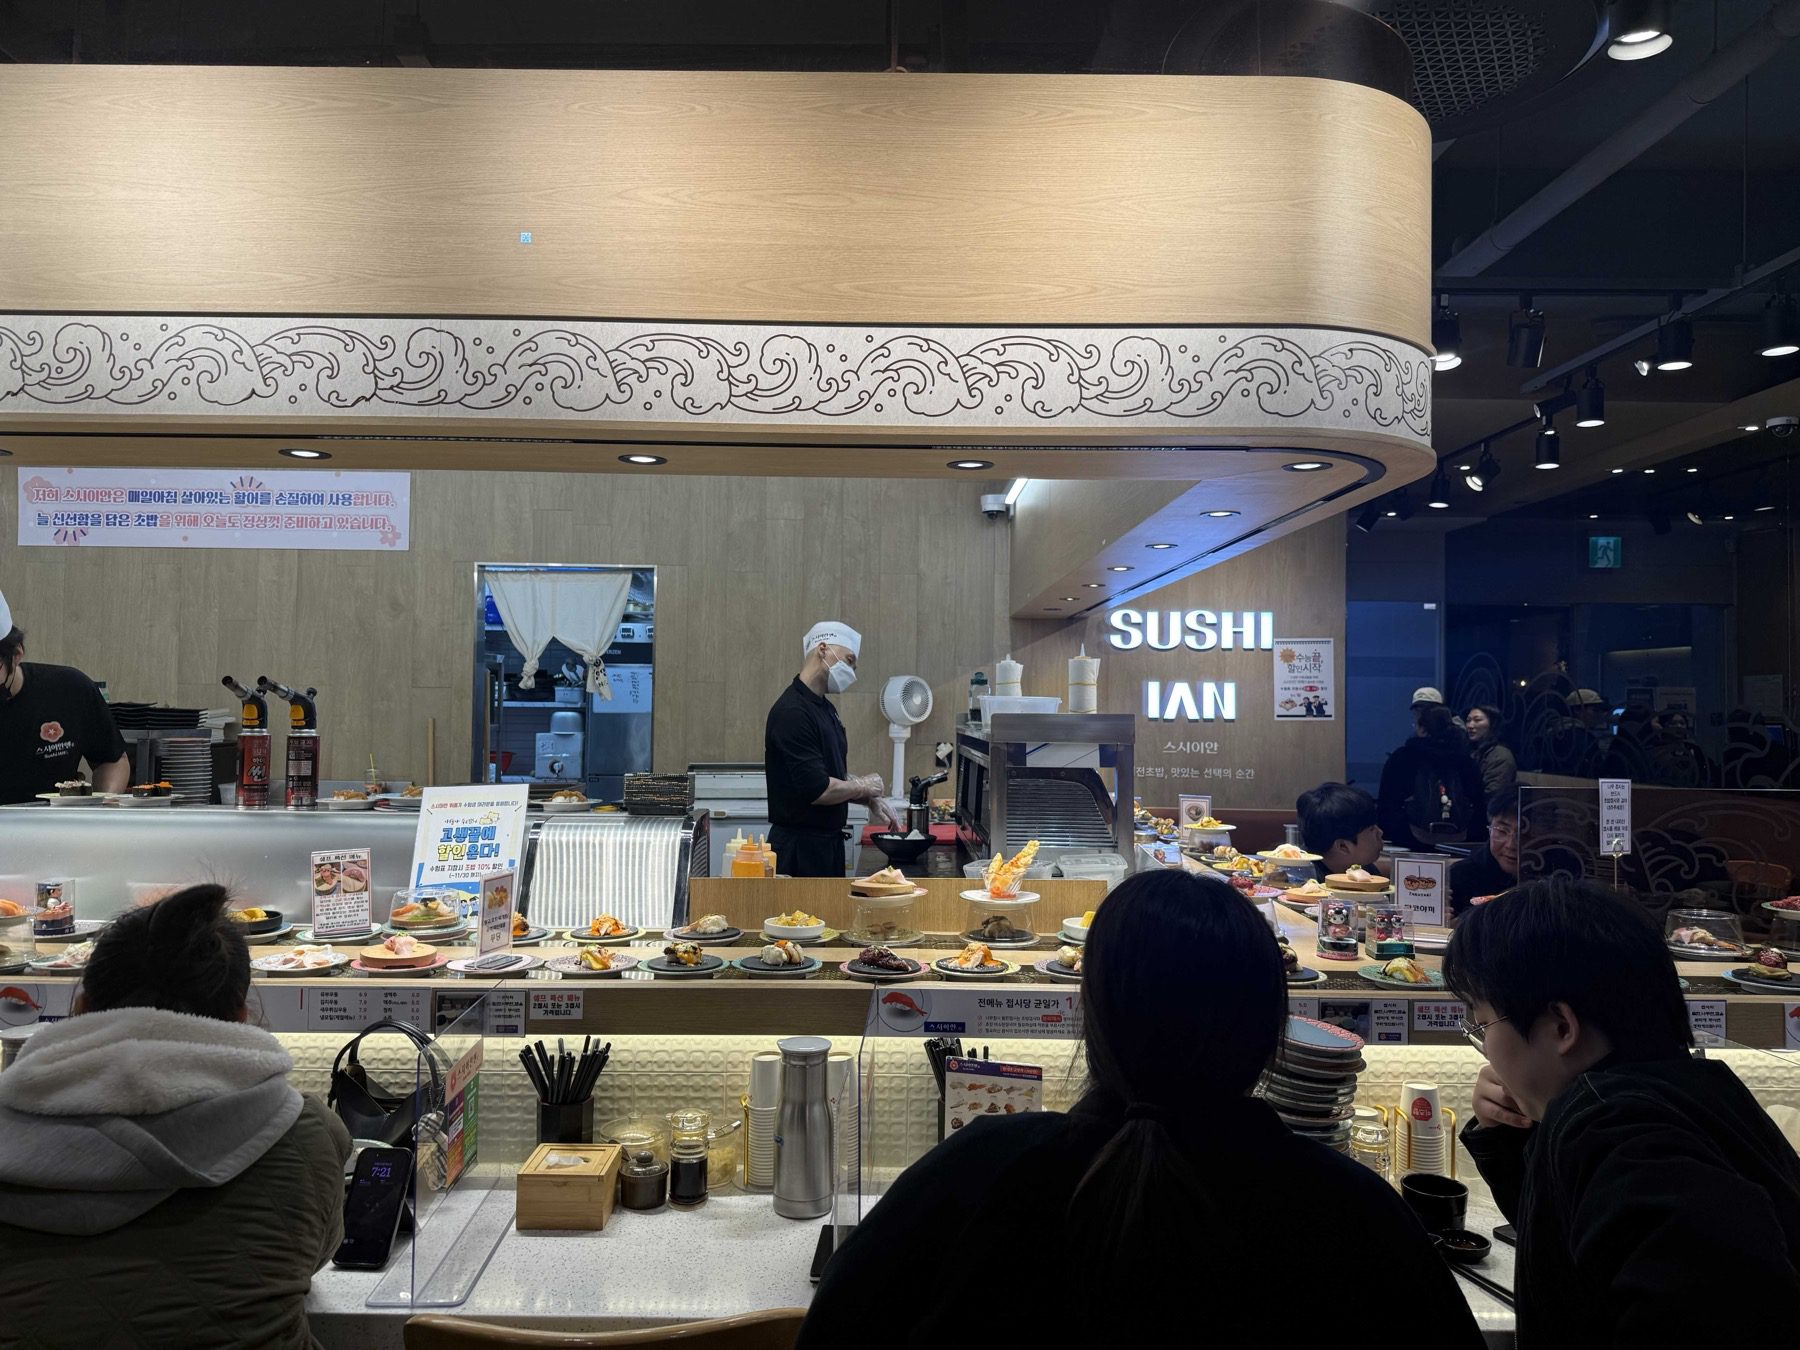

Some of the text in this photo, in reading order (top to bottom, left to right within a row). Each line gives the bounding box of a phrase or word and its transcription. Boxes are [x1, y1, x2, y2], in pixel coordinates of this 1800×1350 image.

[34, 488, 396, 507] 저희 스시이안은 매일아침 살아있는 활어를 손질하여 사용합니다.
[36, 512, 393, 532] 늘 신선함을 담은 초밥을 위해 오늘도 정성껏 준비하고 있습니다.
[1109, 609, 1273, 650] SUSHI
[1162, 741, 1218, 754] 스시이안
[1133, 766, 1255, 780] 전초밥, 맛있는 선택의 순간
[440, 825, 497, 843] 고생끝에
[477, 863, 491, 871] 10%
[977, 998, 1003, 1008] 전메뉴
[1006, 998, 1031, 1009] 접시당
[1034, 998, 1060, 1009] 균일가
[371, 1167, 391, 1178] 7:21
